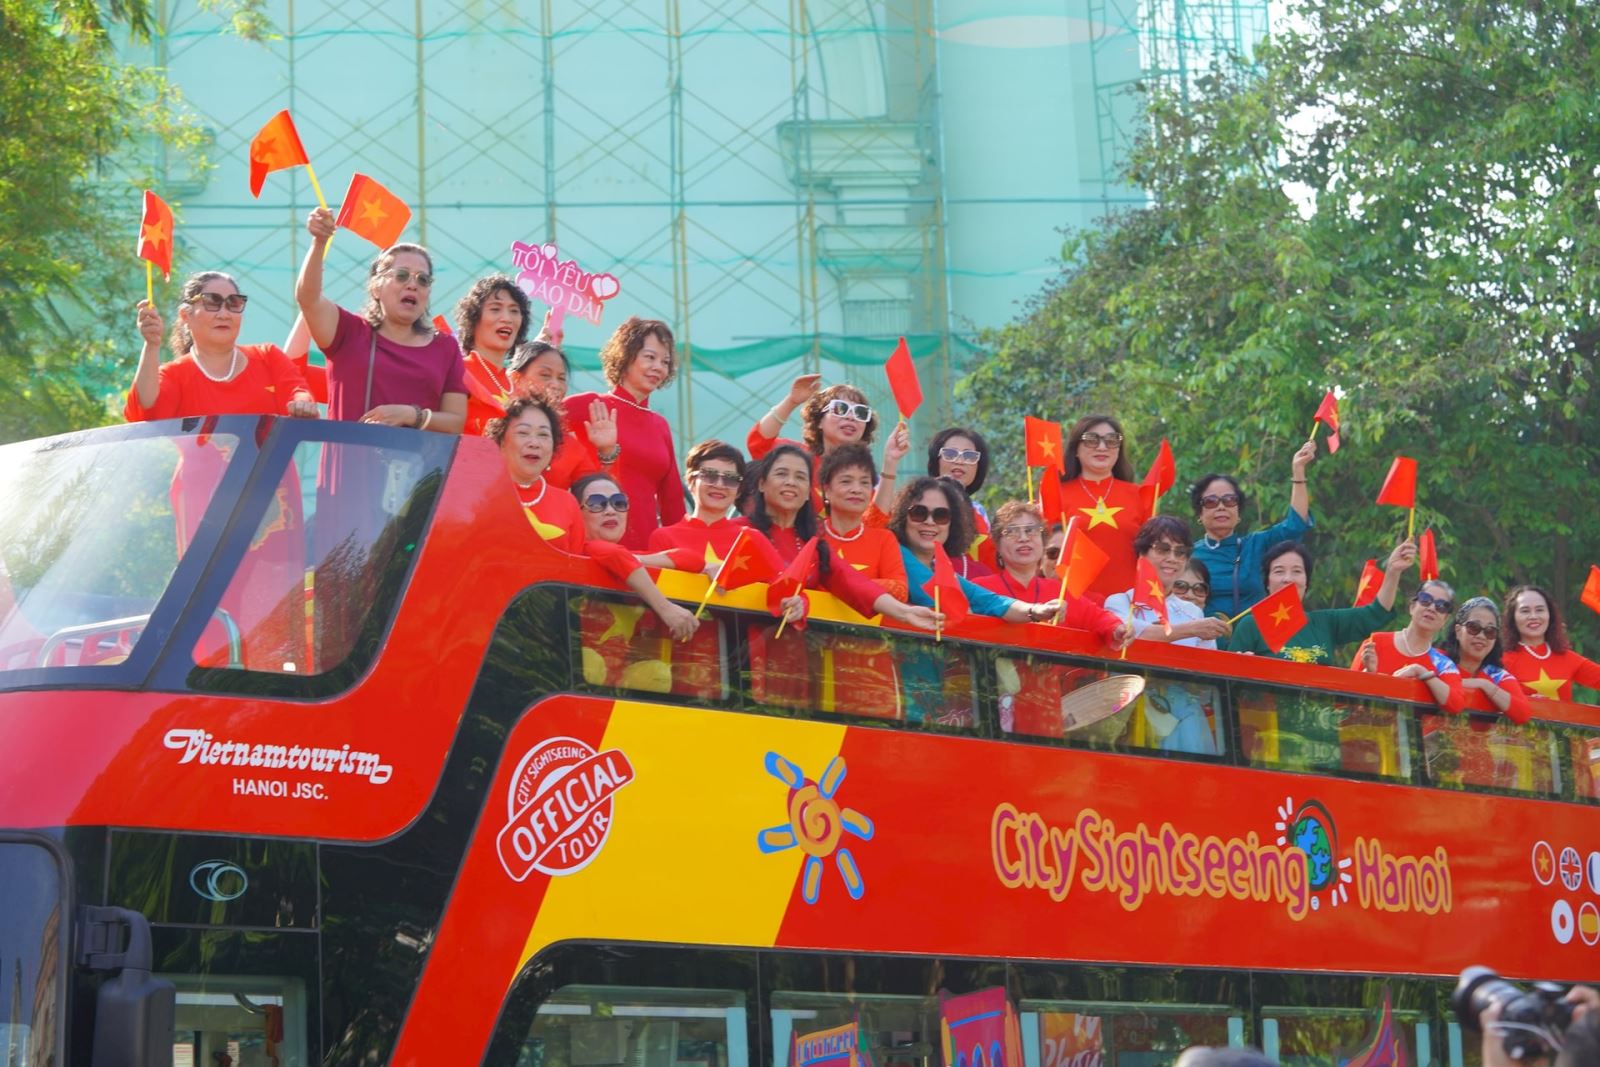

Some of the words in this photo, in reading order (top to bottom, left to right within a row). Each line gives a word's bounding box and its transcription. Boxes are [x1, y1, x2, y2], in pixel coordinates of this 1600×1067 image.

[512, 245, 546, 277] TÔI
[551, 259, 591, 292] YÊU
[534, 277, 564, 305] ÁO
[163, 728, 393, 784] Vietnamtourism
[517, 774, 532, 806] CITY
[527, 746, 586, 780] SIGHTSEEING
[232, 778, 288, 797] HANOI
[291, 783, 329, 800] JSC.
[512, 756, 627, 862] OFFICIAL
[558, 810, 609, 864] TOUR
[1355, 836, 1452, 915] Hanoi
